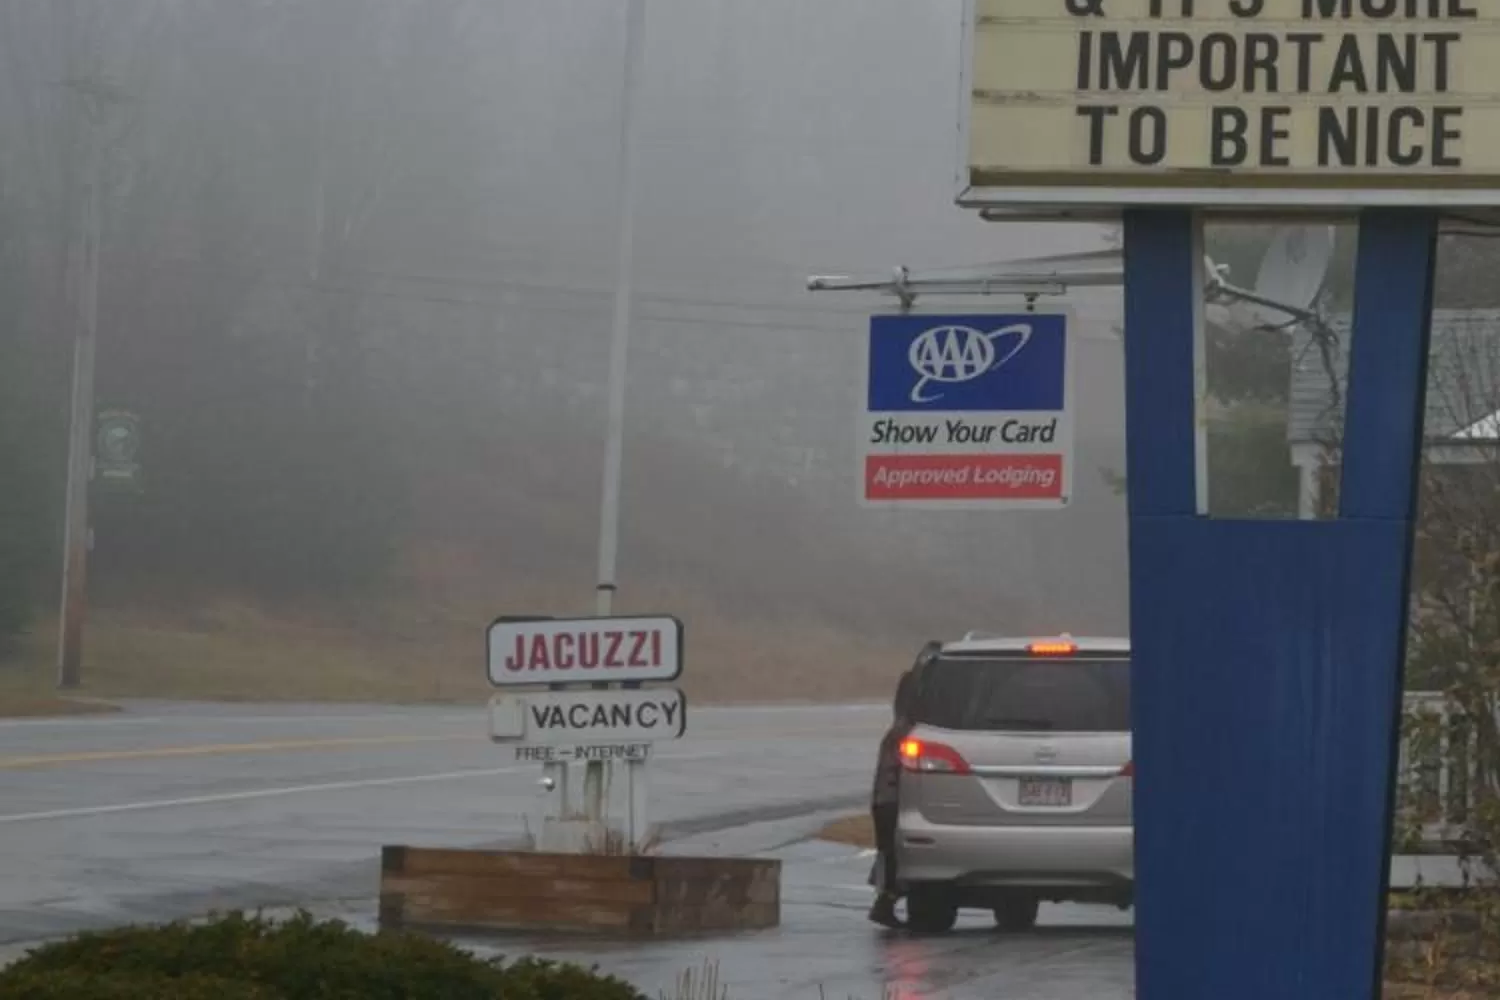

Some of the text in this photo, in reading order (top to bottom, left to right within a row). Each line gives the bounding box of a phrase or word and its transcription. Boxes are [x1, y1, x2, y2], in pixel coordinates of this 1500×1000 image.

[1075, 30, 1460, 93] IMPORTANT
[1075, 105, 1464, 167] TO BE NICE
[911, 325, 992, 380] AAA
[870, 417, 1057, 444] Show Your Card
[873, 464, 1056, 489] Approved Lodging
[505, 629, 663, 672] JACUZZI
[531, 700, 679, 729] VACANCY
[514, 746, 554, 761] FREE
[574, 743, 651, 760] INTERNET
